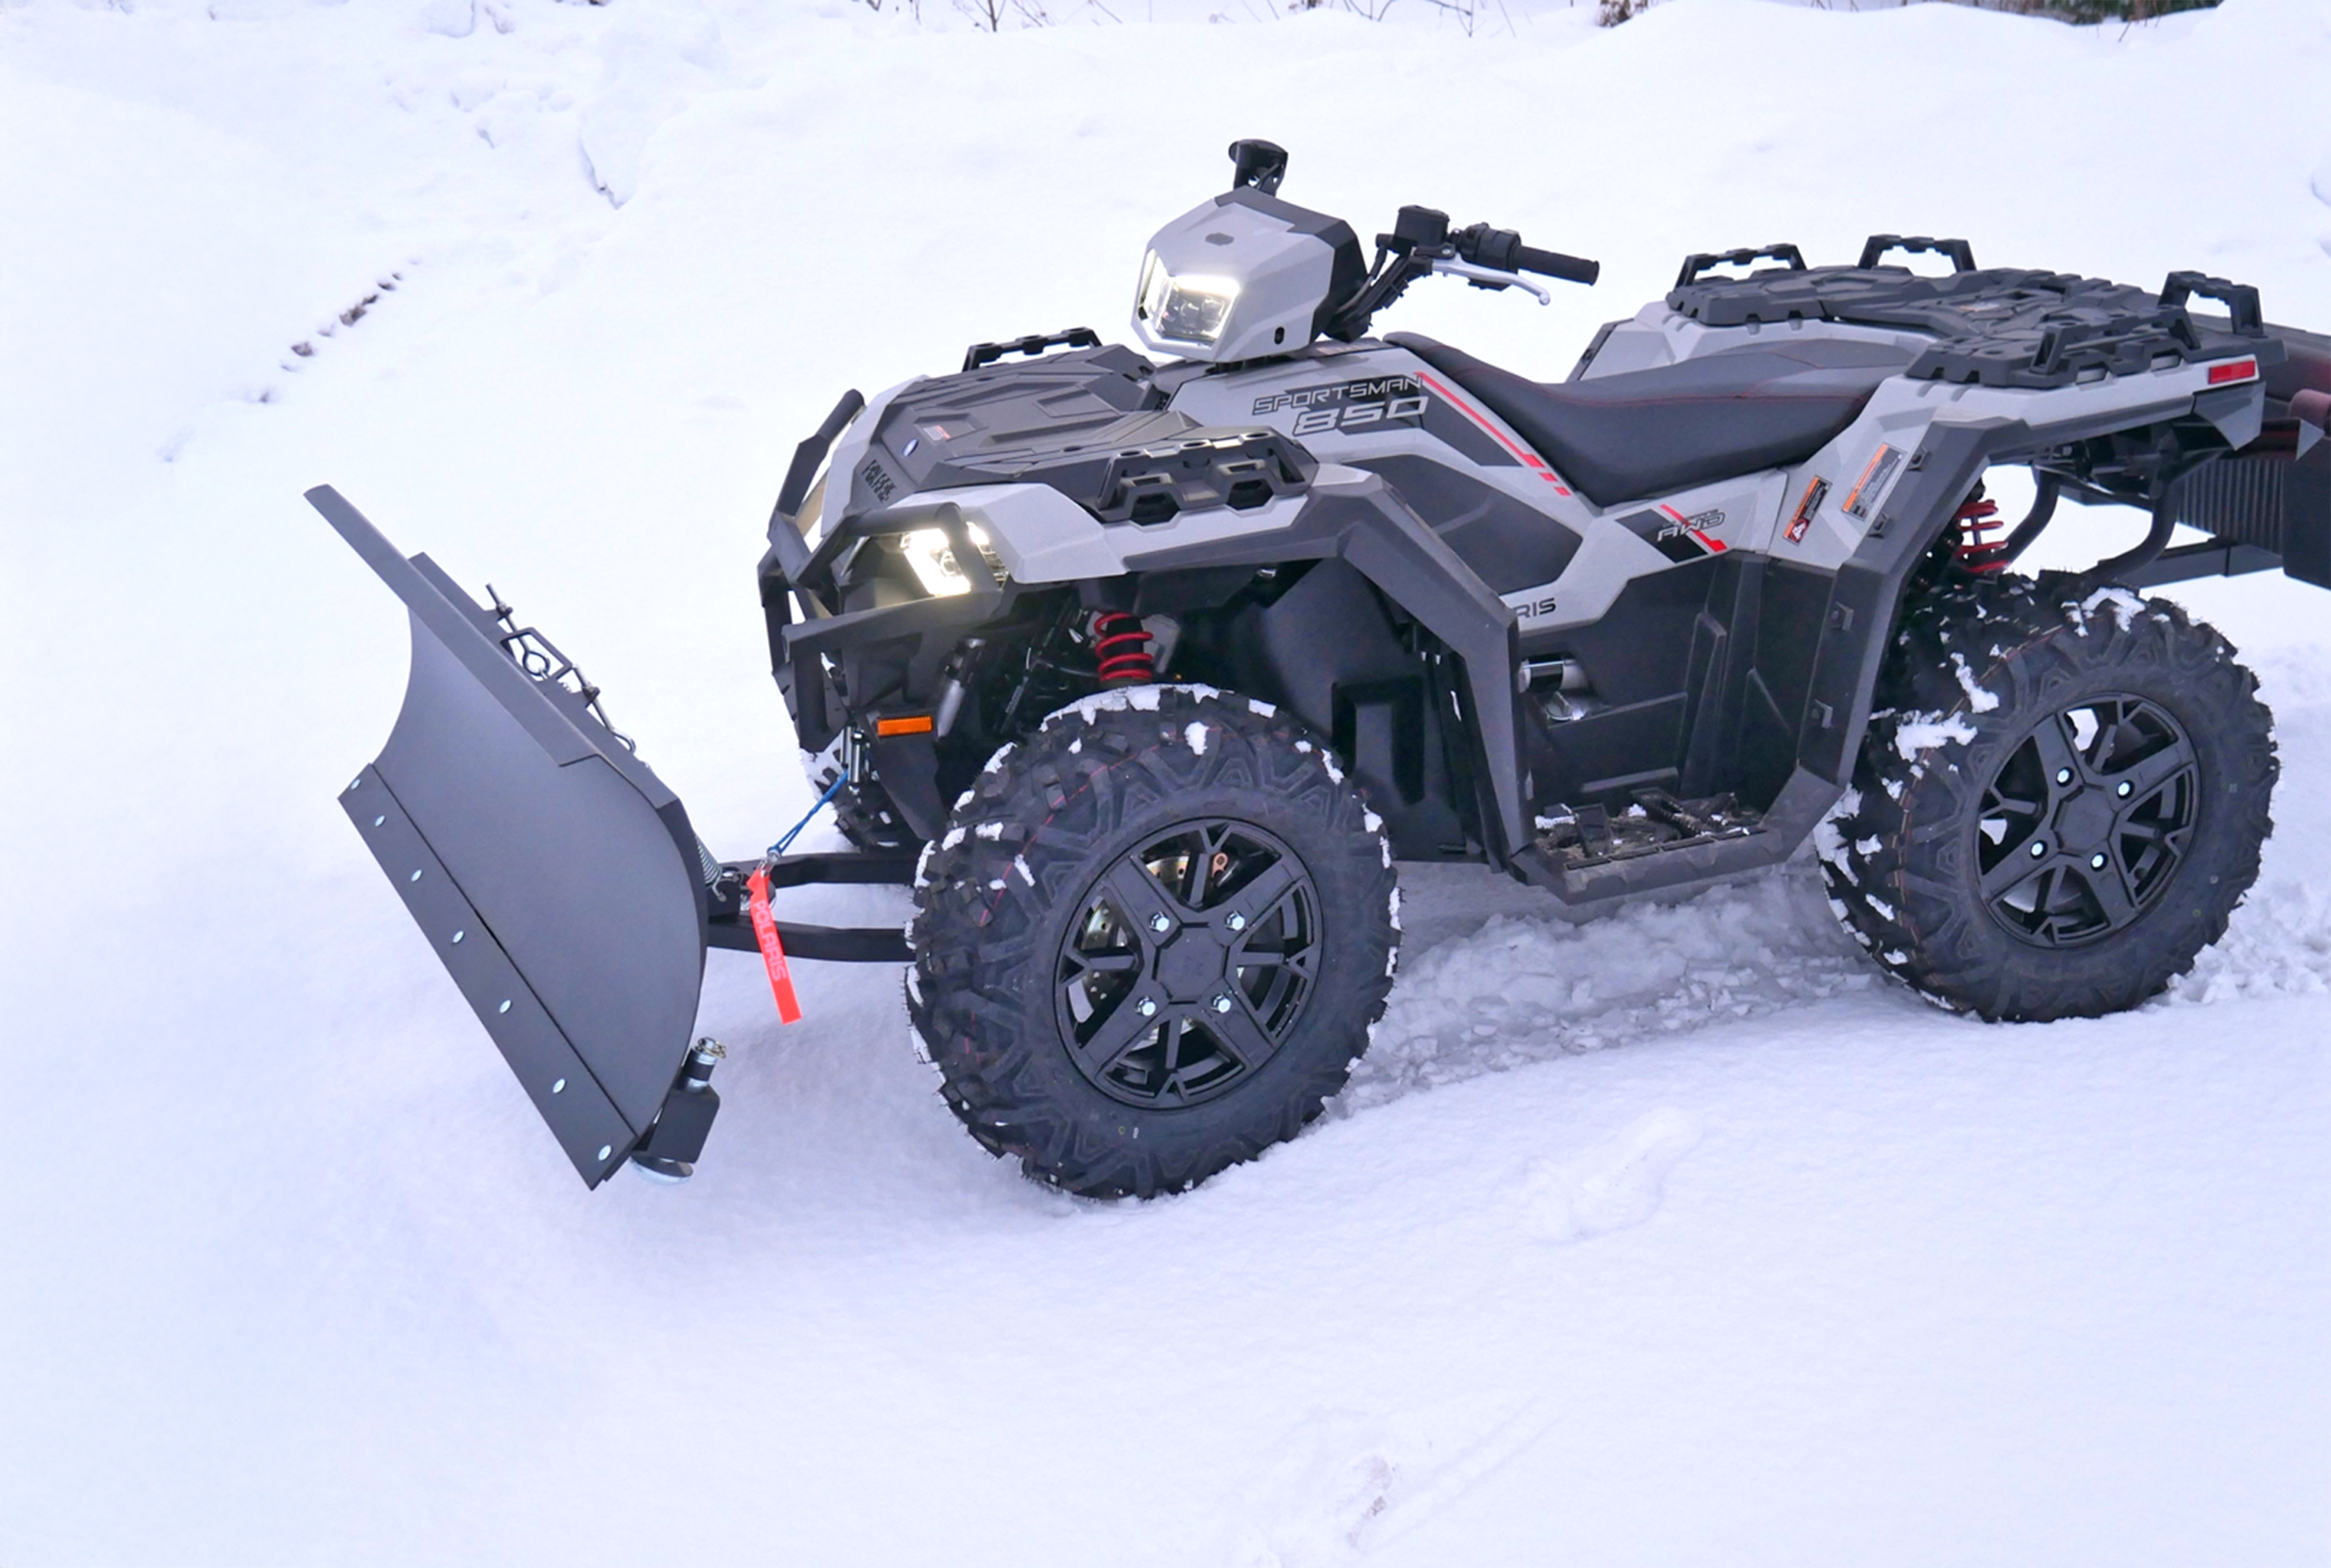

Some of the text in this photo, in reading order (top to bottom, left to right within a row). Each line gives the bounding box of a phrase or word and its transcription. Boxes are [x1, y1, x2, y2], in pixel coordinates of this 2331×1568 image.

[1252, 374, 1424, 416] SPORTSMAN
[1292, 396, 1429, 436] 850
[1657, 512, 1726, 543] AWD
[752, 900, 787, 982] POLARIS
